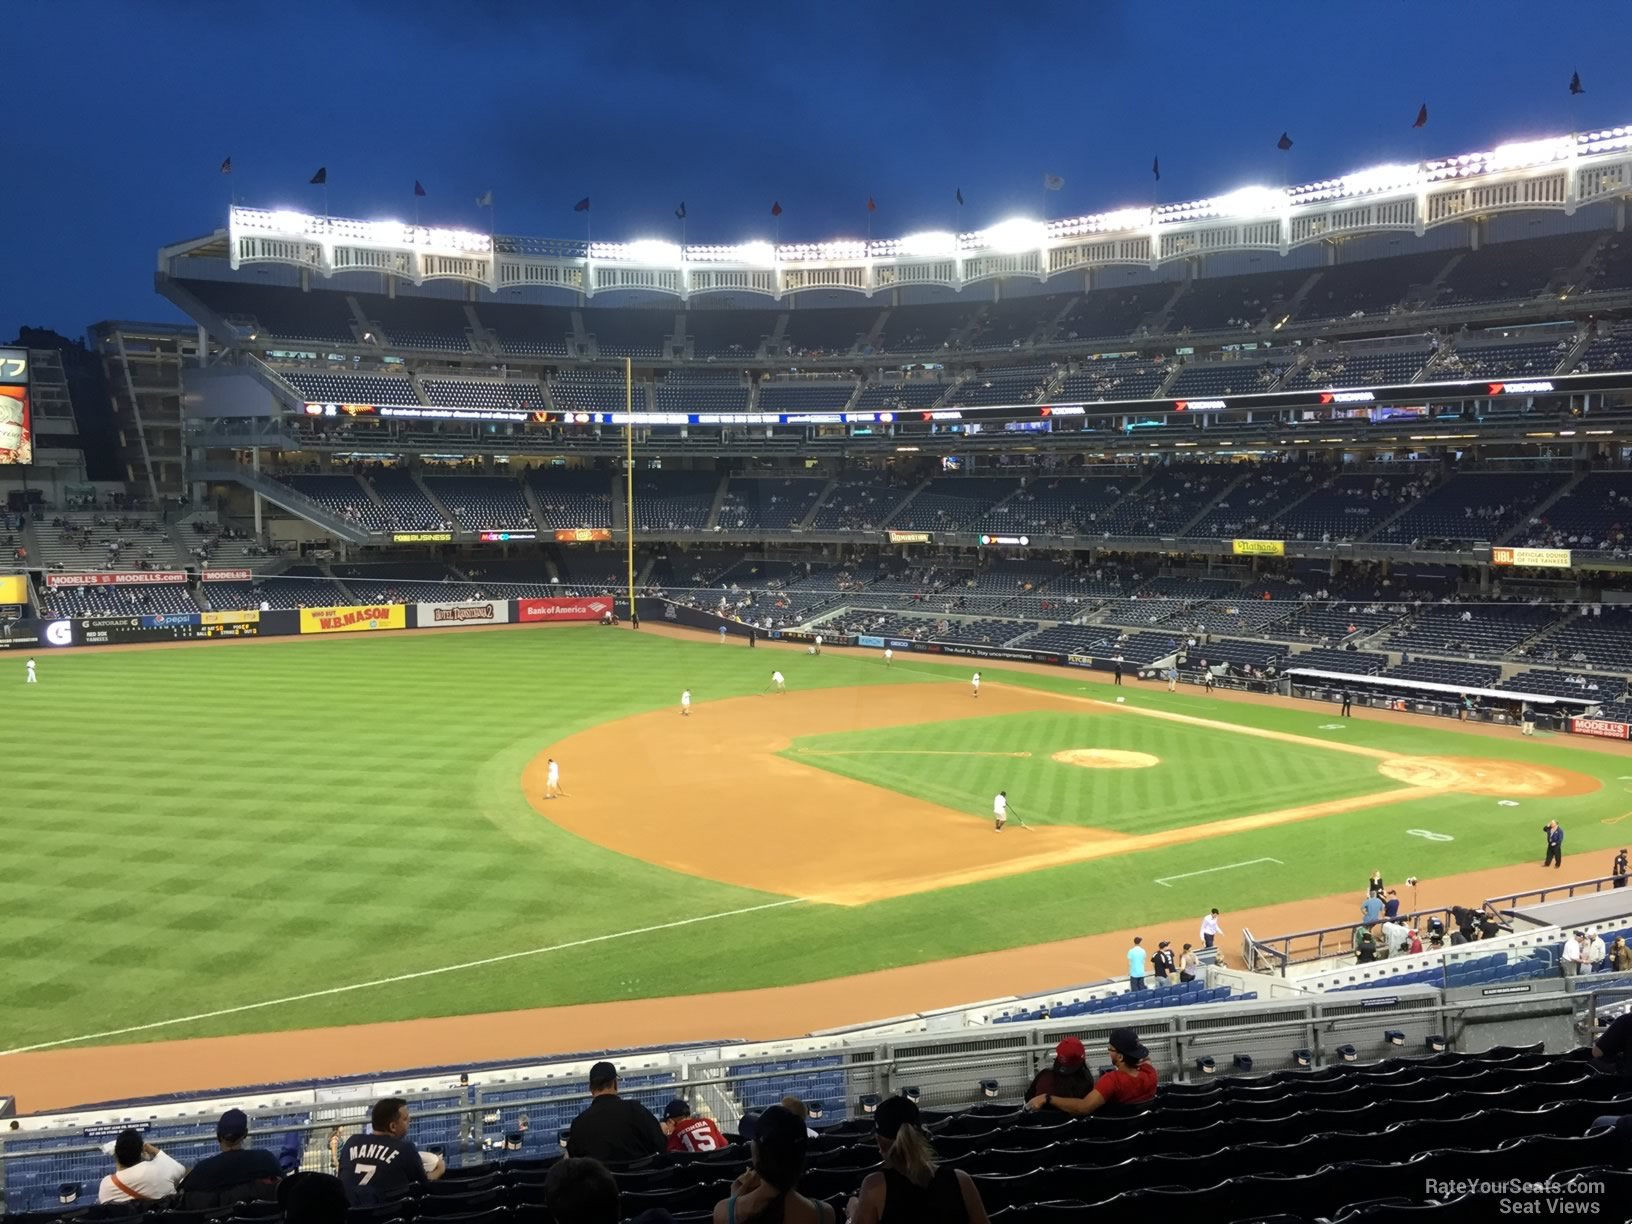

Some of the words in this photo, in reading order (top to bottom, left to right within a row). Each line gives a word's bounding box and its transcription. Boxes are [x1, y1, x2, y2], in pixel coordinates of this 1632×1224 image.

[1493, 550, 1513, 562] JBL
[51, 575, 97, 584] MODELL'S
[116, 574, 183, 582] MODELLS.com
[527, 606, 547, 614] Bank
[547, 606, 555, 614] of
[555, 606, 586, 614] America
[166, 615, 190, 624] pepsi
[1575, 720, 1624, 732] MODELL'S
[682, 1126, 716, 1152] 15
[350, 1144, 400, 1164] MANTLE
[354, 1163, 377, 1186] 7
